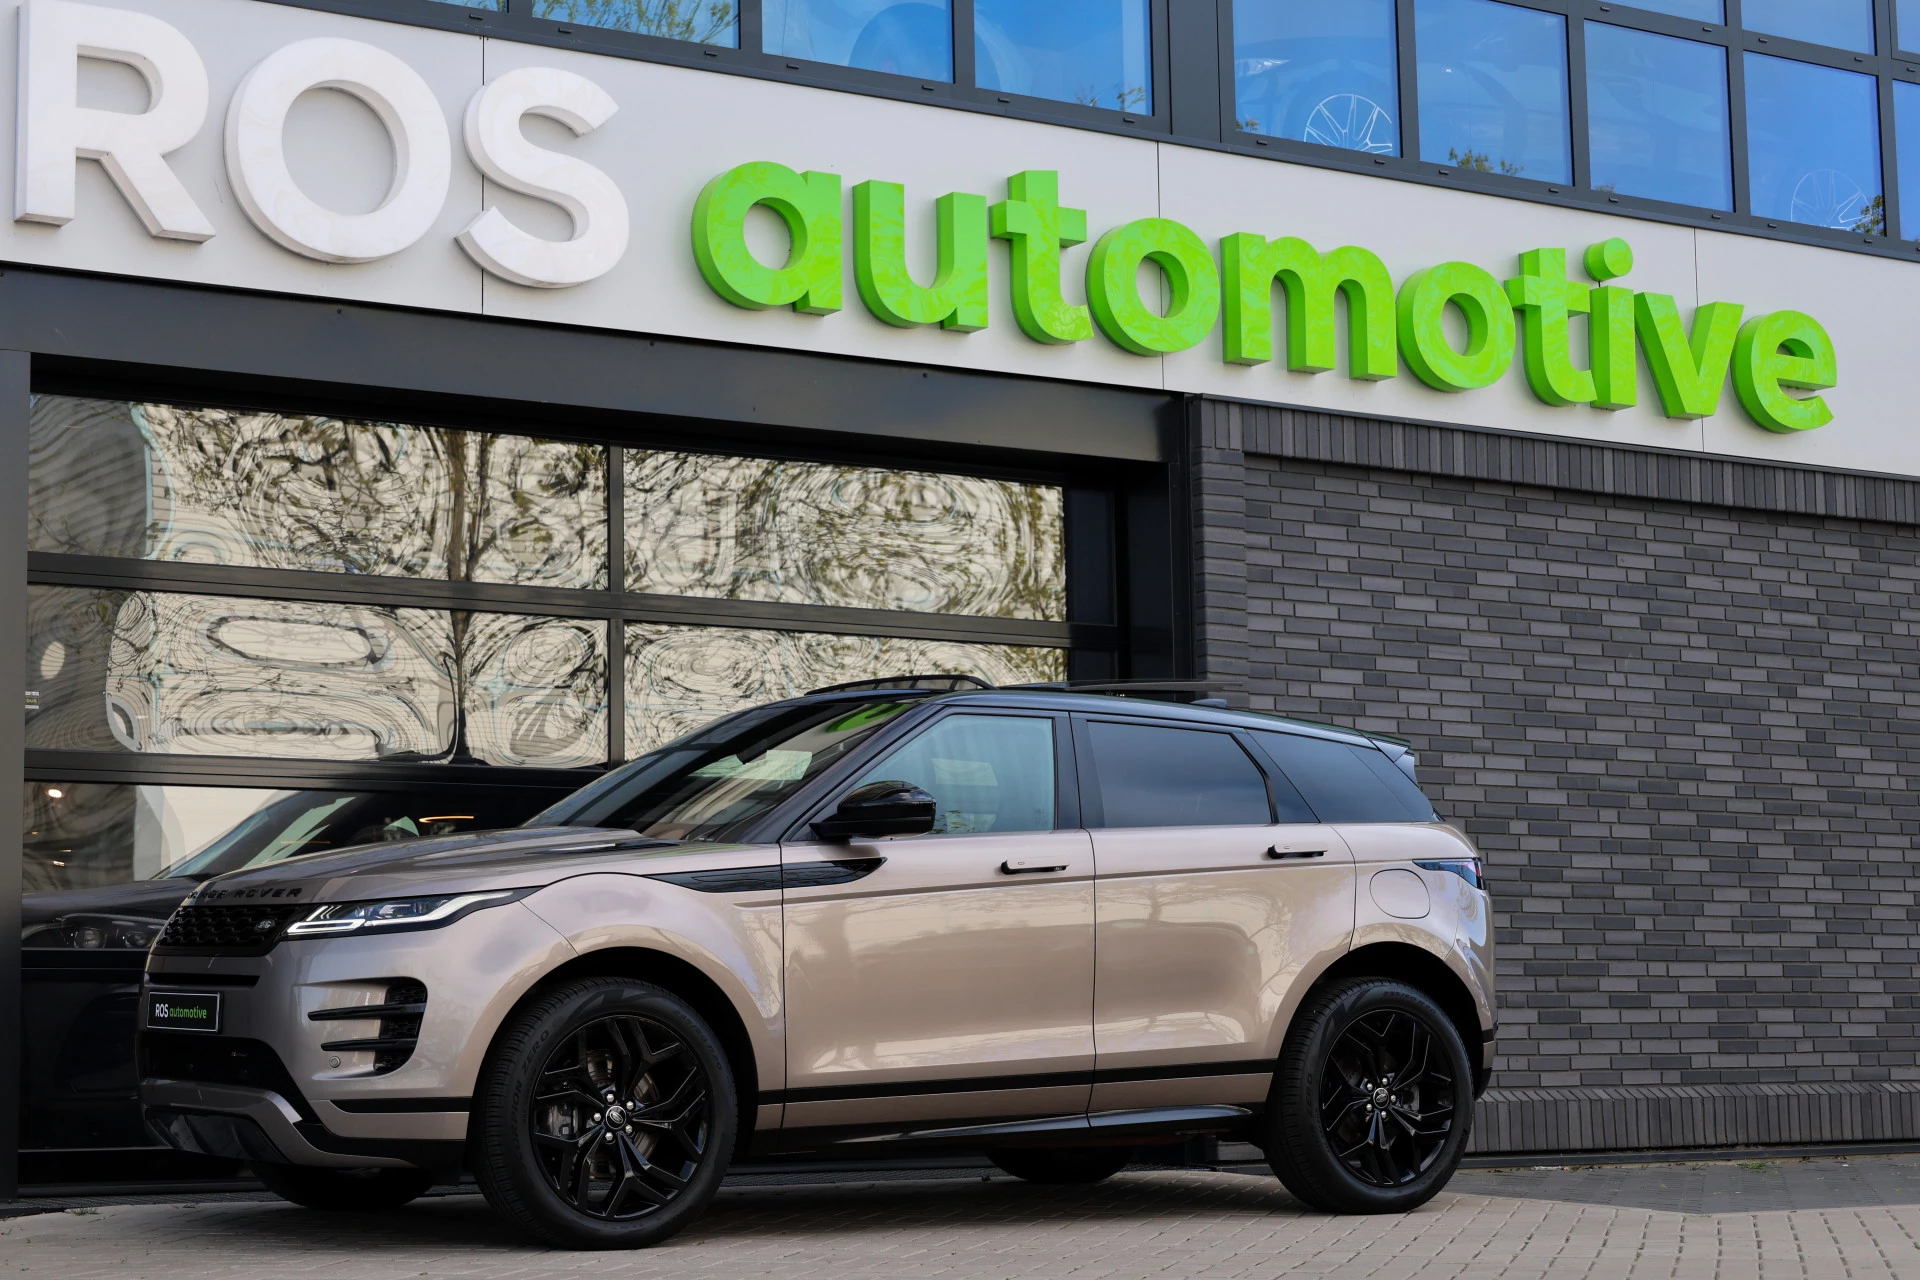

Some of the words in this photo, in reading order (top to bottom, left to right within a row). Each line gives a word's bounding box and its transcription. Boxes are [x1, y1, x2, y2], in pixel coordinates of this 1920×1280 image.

[13, 1, 630, 288] ROS
[691, 161, 1838, 434] automotive
[235, 887, 303, 898] ROVER
[155, 1003, 169, 1018] ROS
[169, 1006, 207, 1018] automotive
